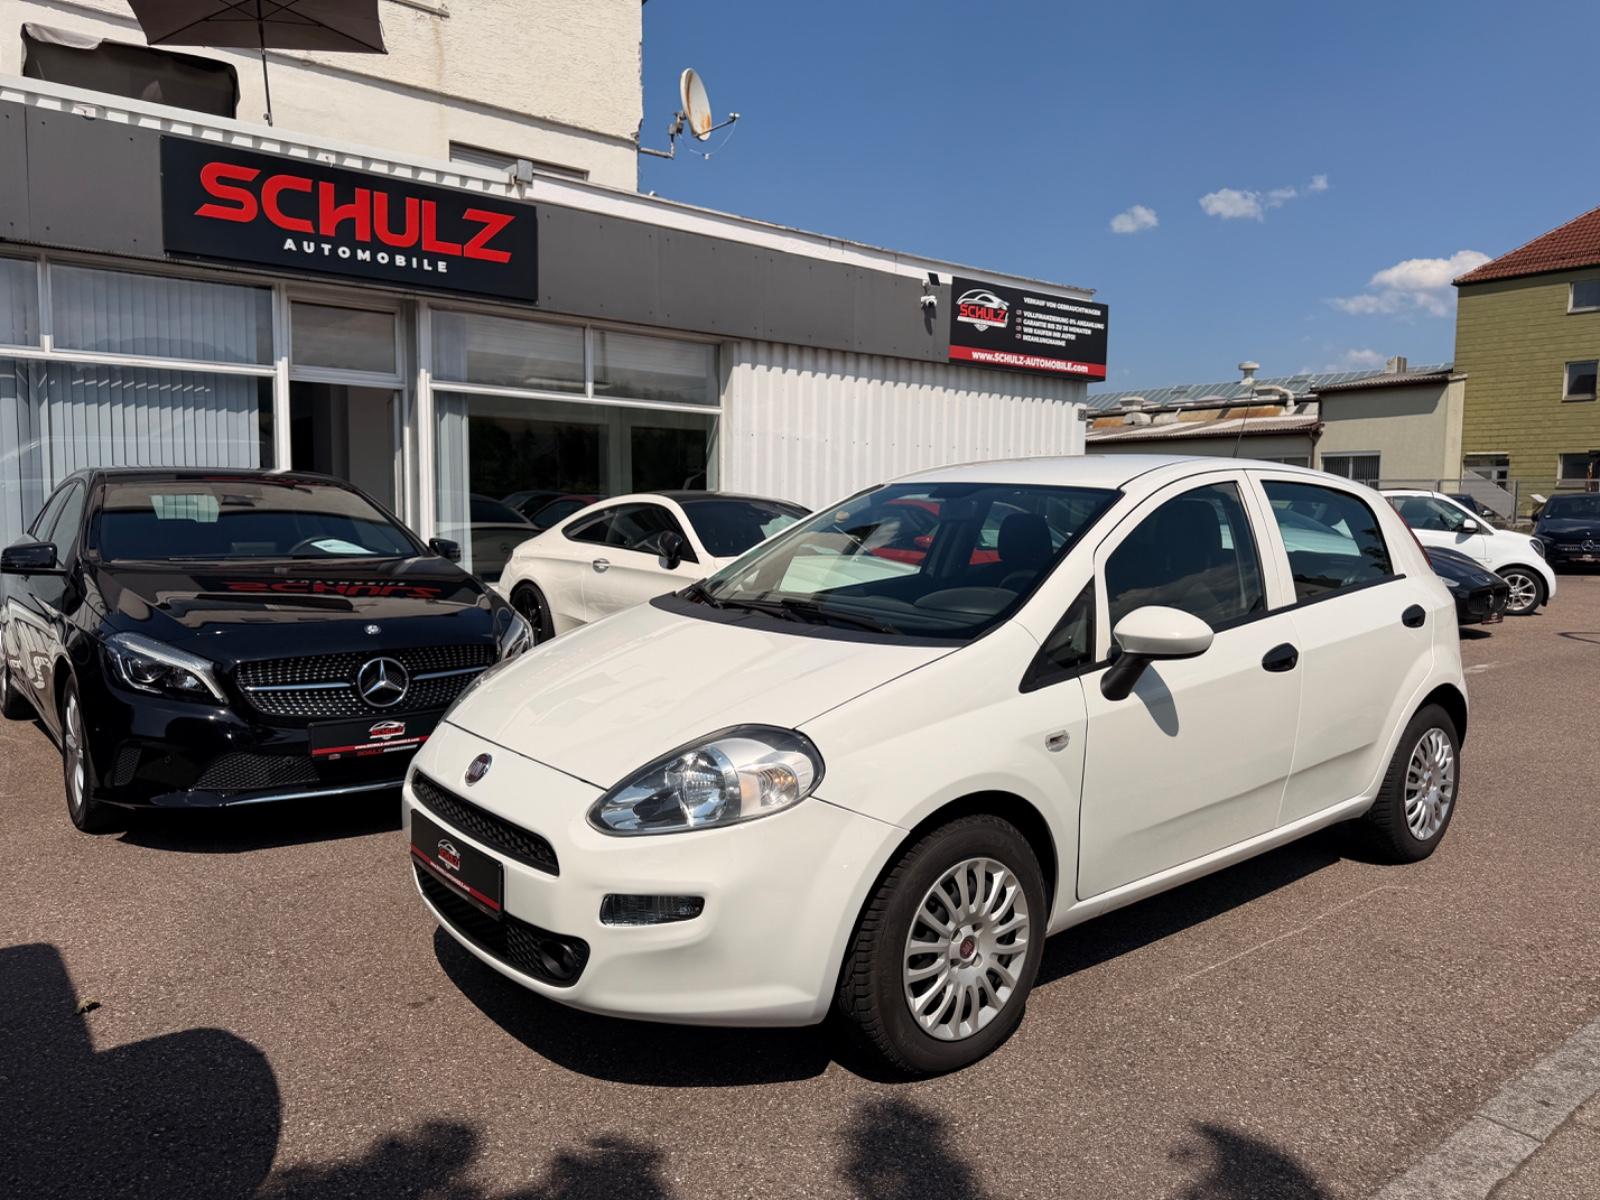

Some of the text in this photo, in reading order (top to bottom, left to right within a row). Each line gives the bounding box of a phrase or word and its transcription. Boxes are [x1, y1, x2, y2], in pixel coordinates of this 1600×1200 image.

[194, 161, 516, 264] SCHULZ
[283, 237, 449, 273] AUTOMOBILE
[959, 303, 1008, 323] SCHULZ
[971, 351, 1089, 373] www.SCHULZ-AUTOMOBILE.com
